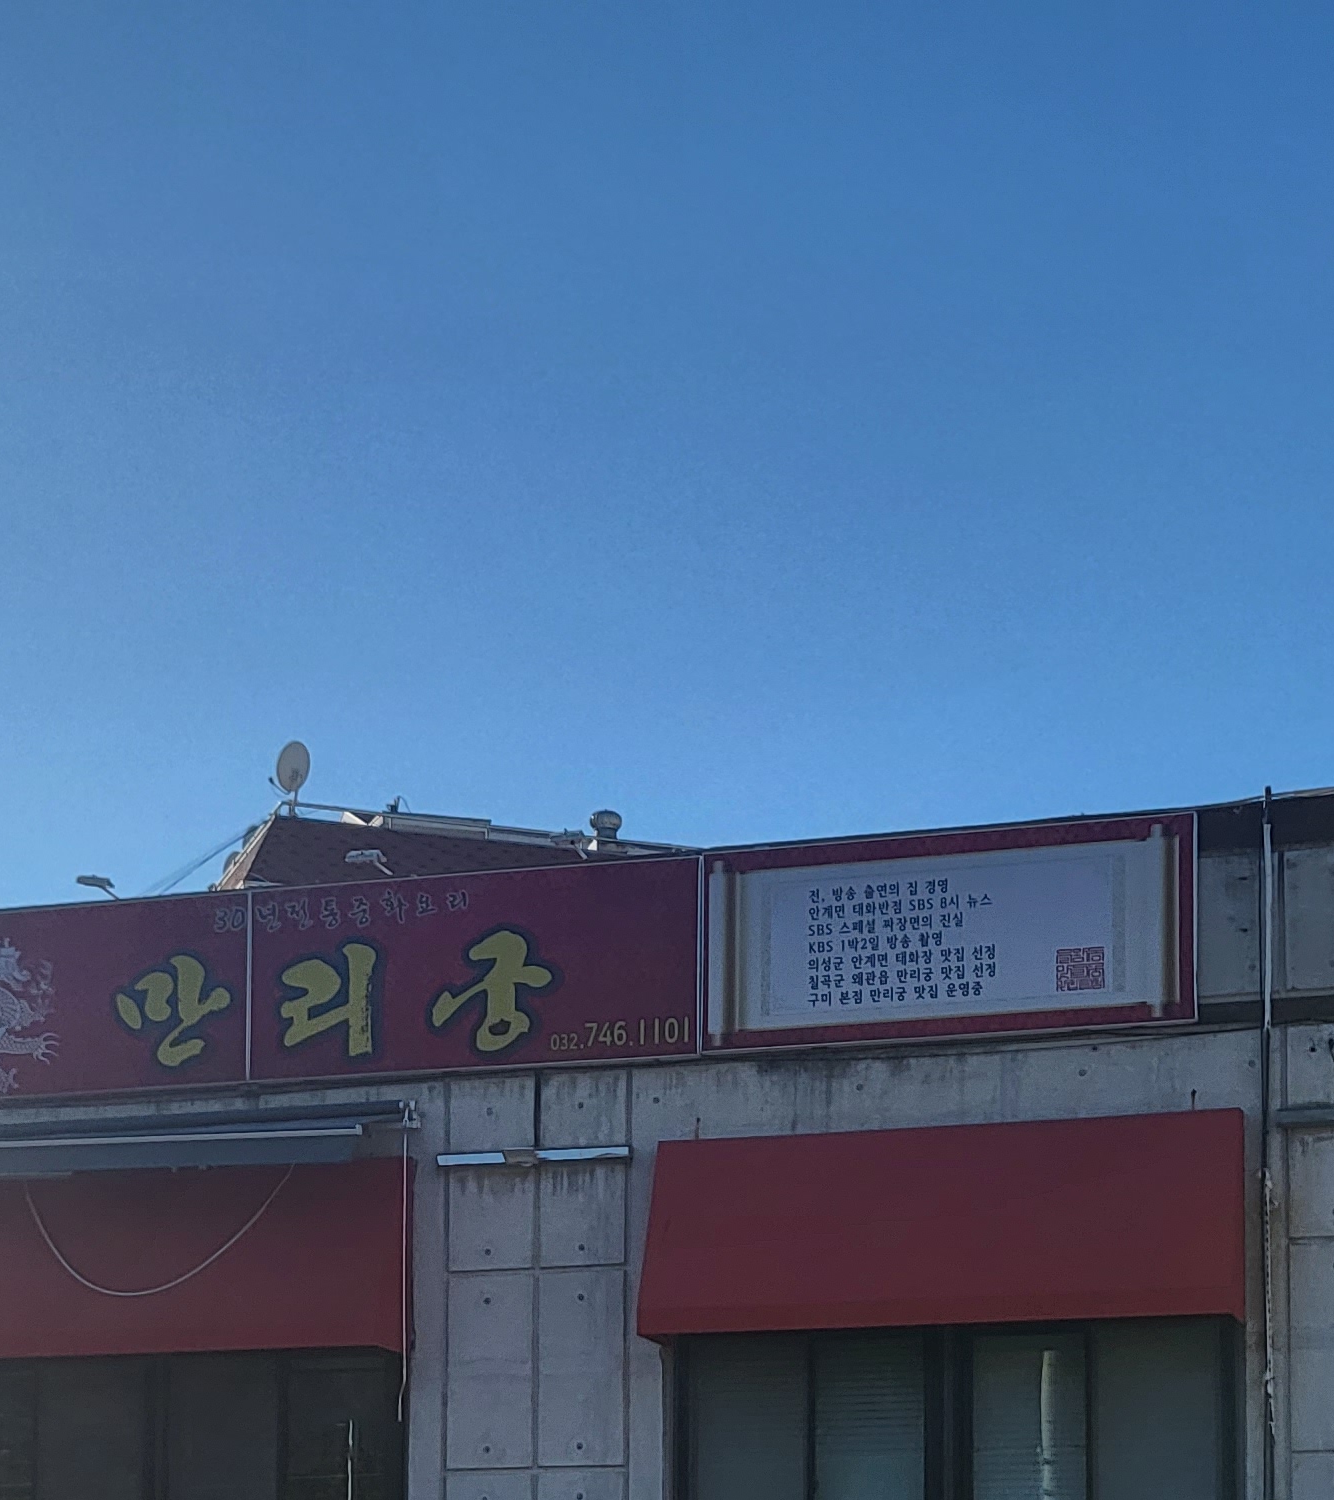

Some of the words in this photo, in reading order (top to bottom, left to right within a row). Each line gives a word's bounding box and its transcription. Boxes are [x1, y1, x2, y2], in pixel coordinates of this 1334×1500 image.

[832, 886, 856, 902] 방송
[863, 881, 900, 899] 출연의
[907, 880, 918, 896] 집
[925, 878, 948, 895] 경영
[809, 904, 845, 921] 안계면
[853, 900, 902, 916] 태화반점
[909, 898, 934, 911] SBS
[940, 894, 959, 909] 8시
[967, 893, 993, 909] 뉴스
[808, 923, 833, 936] SBS
[839, 919, 876, 934] 스페셜
[882, 914, 933, 932] 짜장면의
[939, 912, 963, 928] 진실
[809, 941, 833, 954] KBS
[841, 936, 880, 952] 1박2일
[886, 934, 912, 950] 방송
[918, 931, 943, 947] 촬영
[808, 957, 845, 972] 의성군
[851, 952, 888, 970] 안계면
[895, 949, 933, 966] 태화장
[940, 946, 965, 963] 맛집
[972, 943, 996, 961] 선정
[808, 974, 845, 990] 칠곡군
[851, 970, 889, 986] 왜관읍
[897, 967, 934, 983] 만리궁
[941, 964, 965, 981] 맛집
[972, 962, 996, 979] 선정
[115, 929, 554, 1067] 만리궁
[808, 991, 832, 1007] 구미
[839, 989, 863, 1005] 본점
[870, 986, 908, 1003] 만리궁
[914, 984, 938, 1000] 맛집
[946, 981, 983, 998] 운영중
[550, 1016, 690, 1051] 032.746.1101
